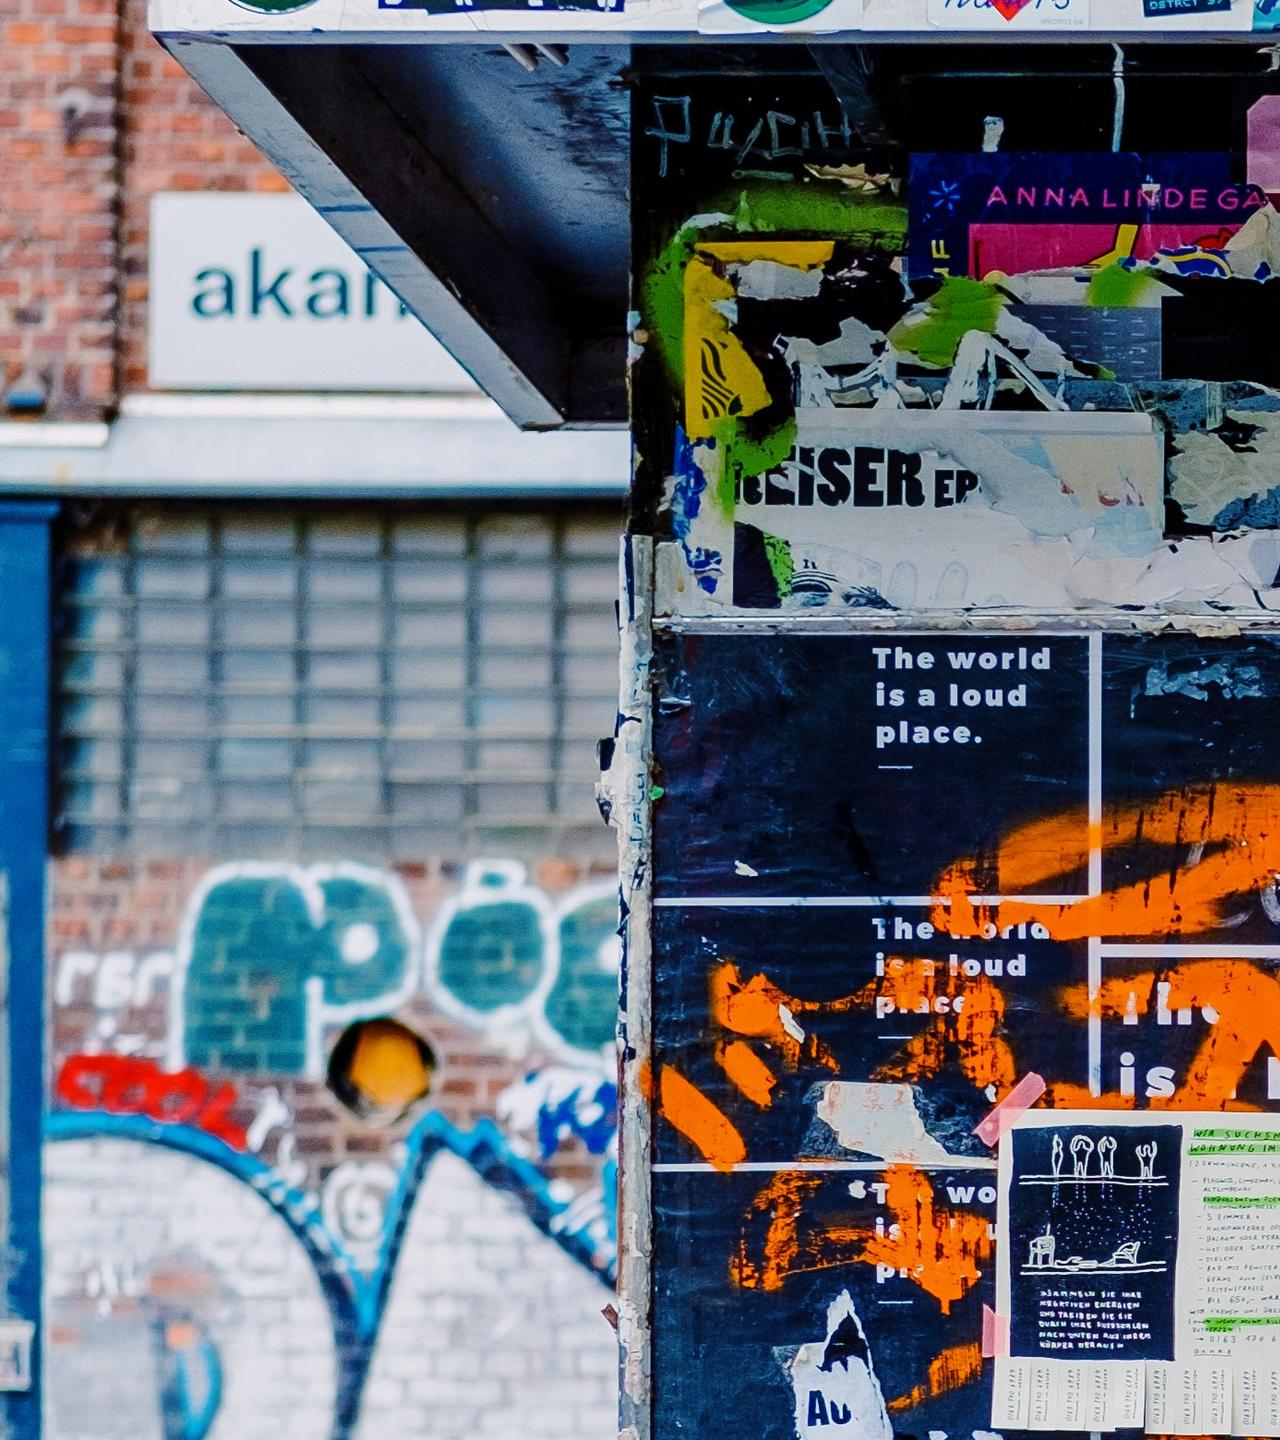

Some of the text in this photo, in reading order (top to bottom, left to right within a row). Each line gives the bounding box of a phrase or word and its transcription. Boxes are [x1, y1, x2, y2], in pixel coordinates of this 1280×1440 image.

[986, 185, 1090, 209] ANNA
[872, 647, 1052, 671] The world
[876, 684, 1028, 708] is a loud
[876, 721, 984, 748] place.
[1119, 1052, 1176, 1097] is
[1190, 1144, 1255, 1153] WOHNUNG
